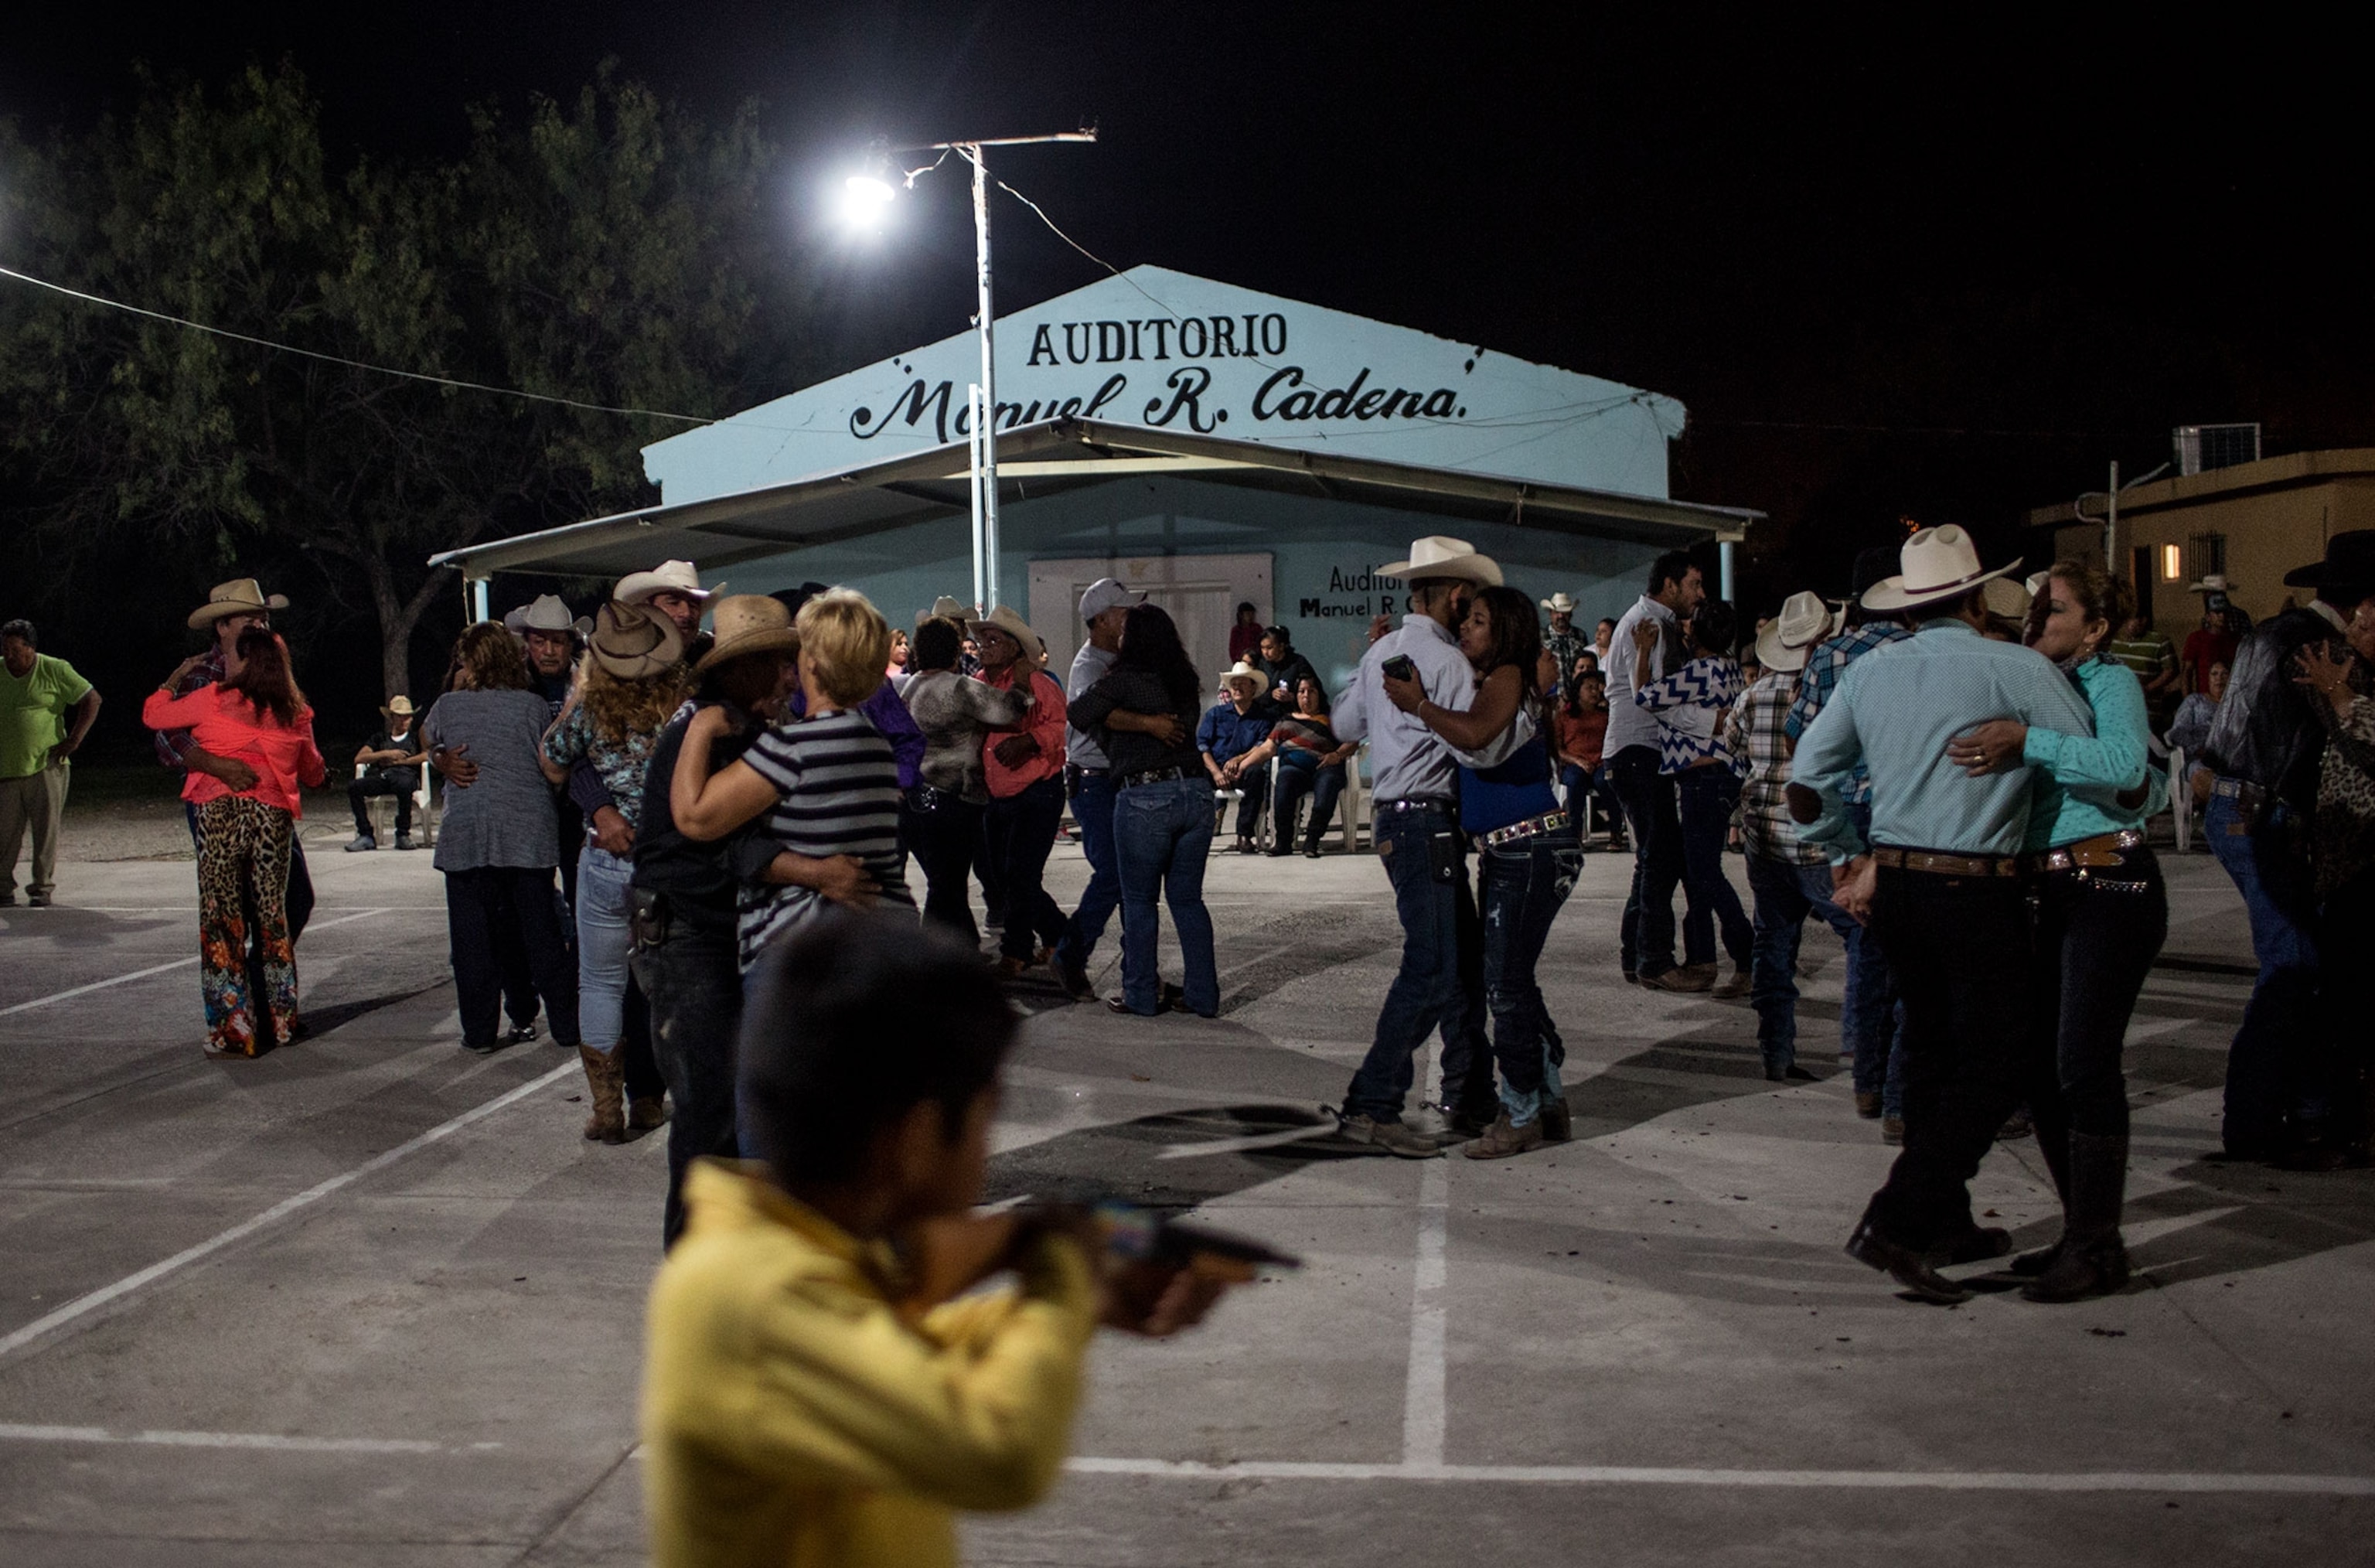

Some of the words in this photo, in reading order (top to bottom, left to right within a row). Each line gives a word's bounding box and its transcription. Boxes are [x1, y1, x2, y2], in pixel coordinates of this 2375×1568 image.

[1026, 312, 1287, 366] AUDITORIO
[1143, 366, 1228, 434] R.
[1329, 565, 1413, 593] Audito
[1300, 596, 1370, 618] Manuel
[1381, 595, 1398, 615] R.
